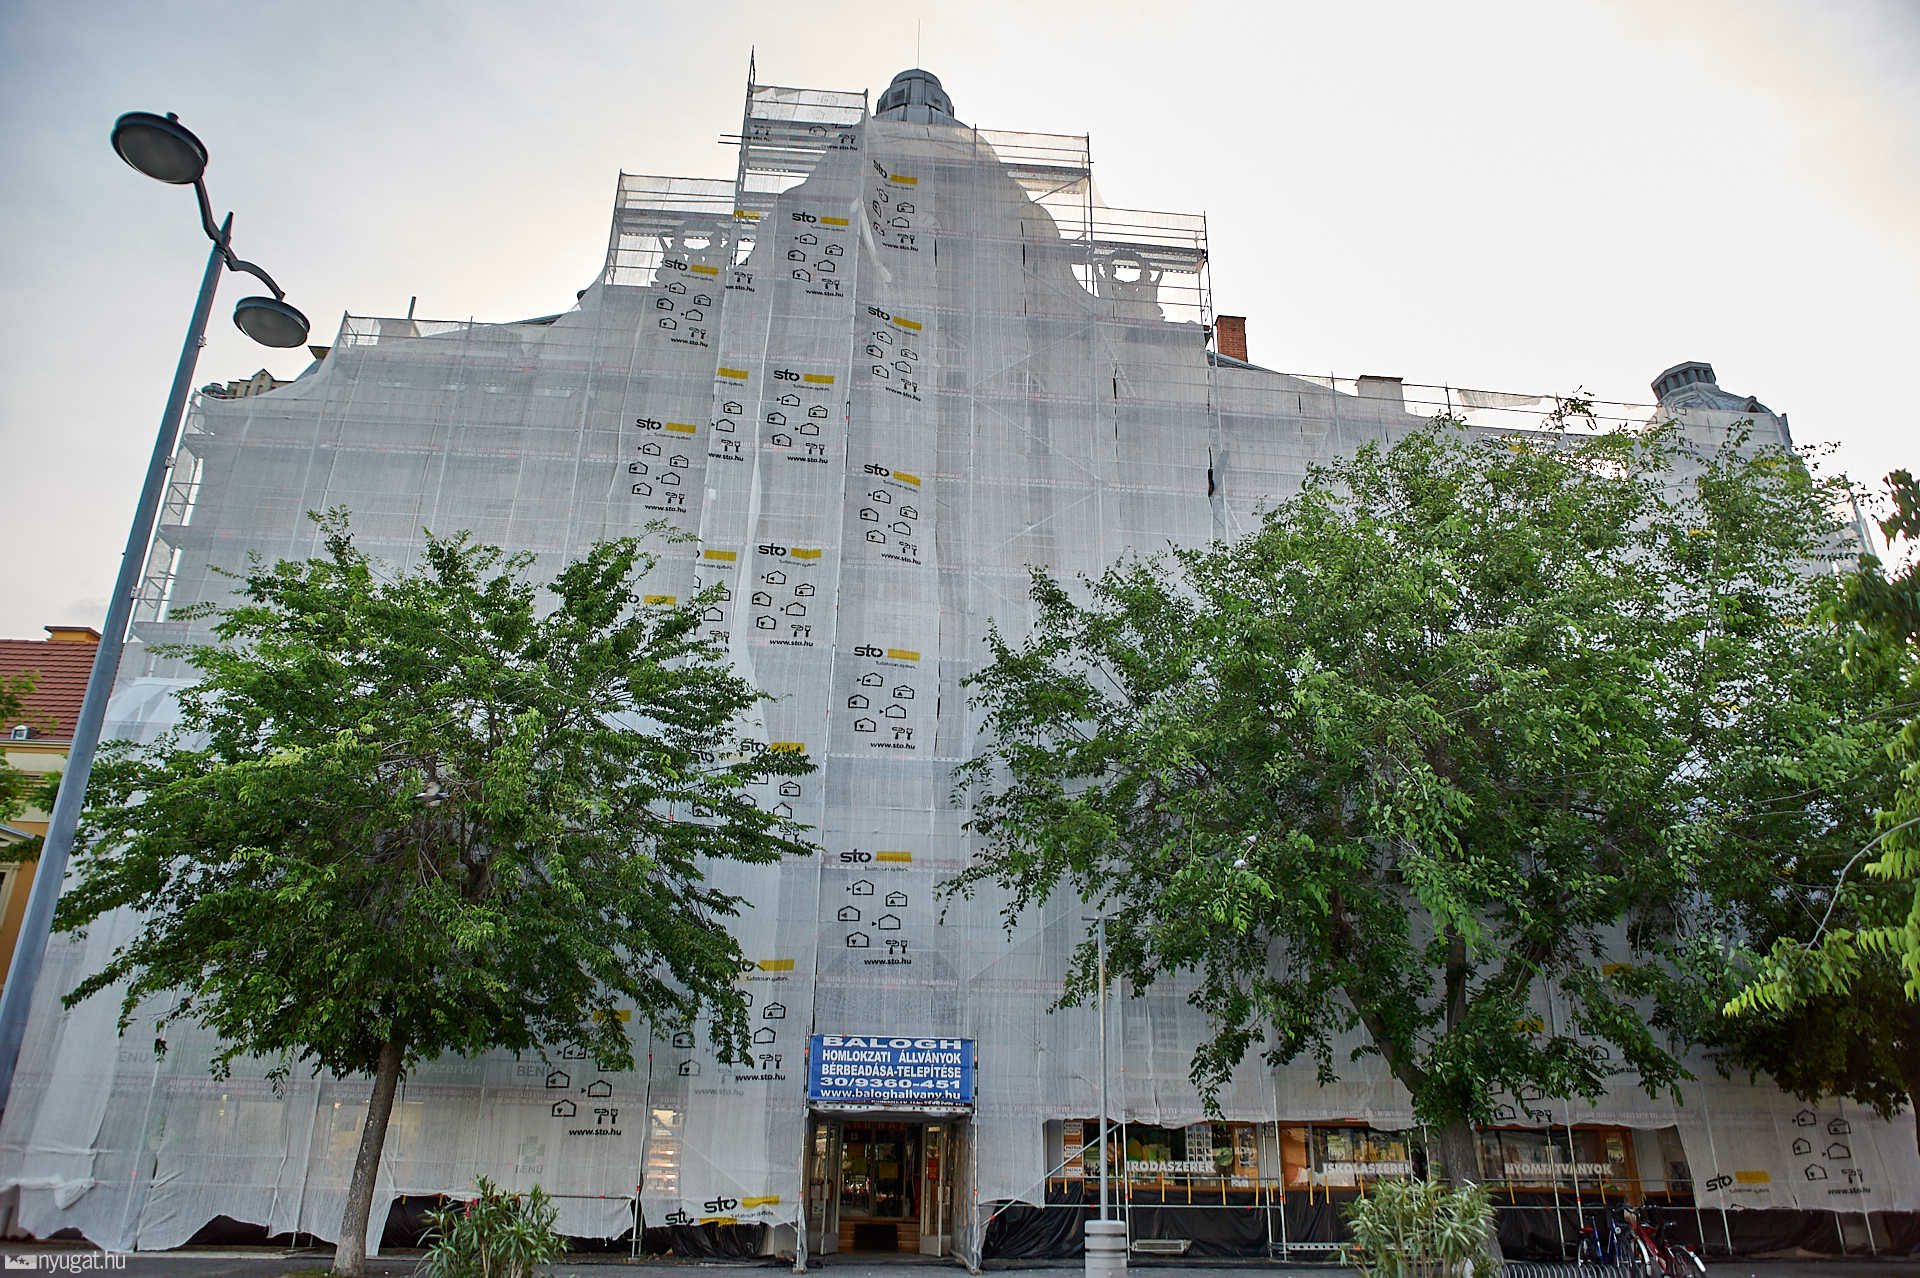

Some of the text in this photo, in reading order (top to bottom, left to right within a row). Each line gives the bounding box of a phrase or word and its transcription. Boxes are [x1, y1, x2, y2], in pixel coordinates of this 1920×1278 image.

[792, 212, 816, 224] sto
[882, 242, 919, 252] www.sto.hu
[664, 259, 688, 272] sto
[806, 288, 844, 298] www.sto.hu
[868, 306, 890, 321] sto
[670, 337, 708, 348] www.sto.hu
[774, 368, 800, 382] sto
[885, 386, 921, 402] www.sto.hu
[636, 418, 662, 431] sto
[787, 455, 828, 464] www.sto.hu
[864, 463, 890, 478] sto
[645, 504, 686, 514] www.sto.hu
[758, 543, 786, 557] sto
[881, 552, 921, 566] www.sto.hu
[770, 638, 814, 648] www.sto.hu
[854, 644, 883, 658] sto
[870, 741, 916, 750] www.sto.hu
[840, 849, 872, 863] sto
[864, 957, 912, 966] www.sto.hu
[822, 1036, 962, 1050] BALOGH
[822, 1050, 961, 1064] HOMLOKZATI ÁLLVÁNYOK
[736, 1073, 786, 1081] www.sto.hu
[822, 1063, 961, 1078] BÉRBEADÁSA-TELEPÍTÉSE
[820, 1078, 960, 1088] 30/9360-451
[820, 1088, 961, 1101] www.baloghallvany.hu
[568, 1128, 622, 1136] www.sto.hu
[1126, 1160, 1216, 1173] IRODASZEREK
[1706, 1172, 1732, 1192] sto
[704, 1196, 738, 1213] sto
